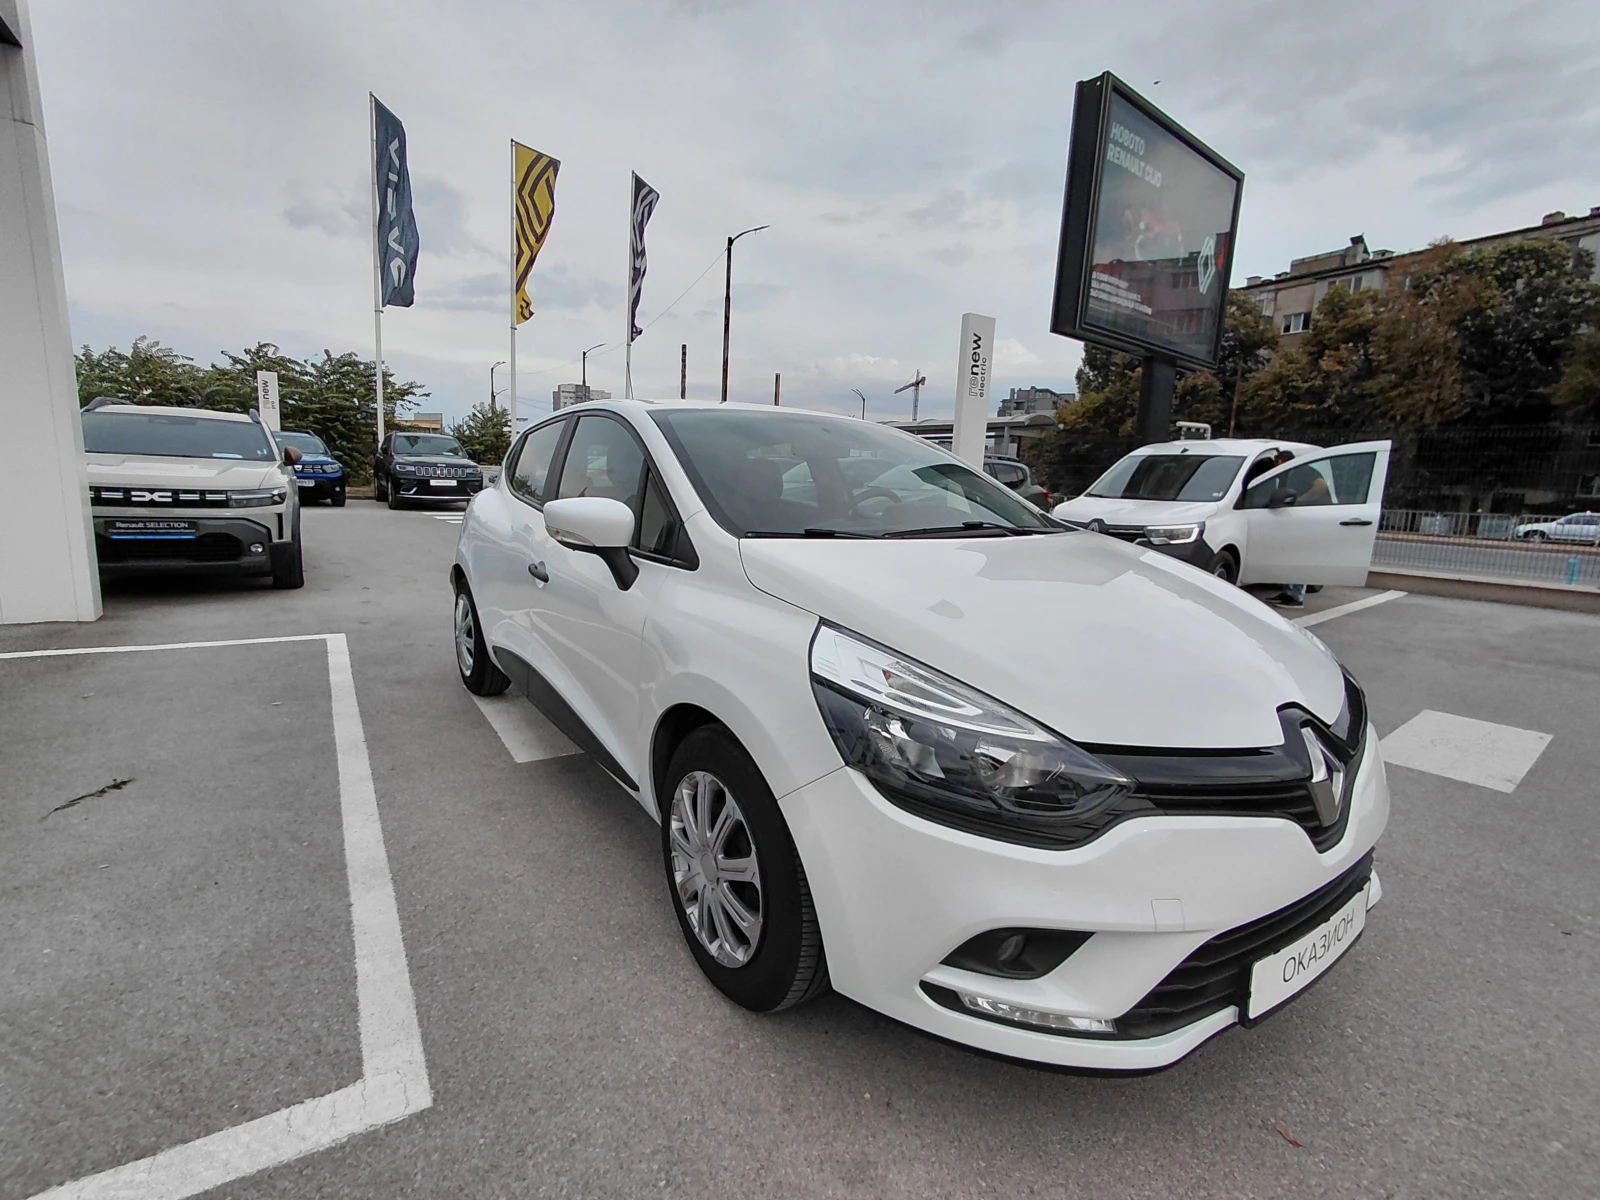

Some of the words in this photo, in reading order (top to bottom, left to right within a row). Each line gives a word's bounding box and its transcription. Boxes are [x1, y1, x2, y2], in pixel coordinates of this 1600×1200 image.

[1107, 143, 1146, 178] RENAULT
[969, 332, 982, 397] renew
[978, 357, 987, 398] electric
[1282, 907, 1355, 983] ОКАЗИОН
